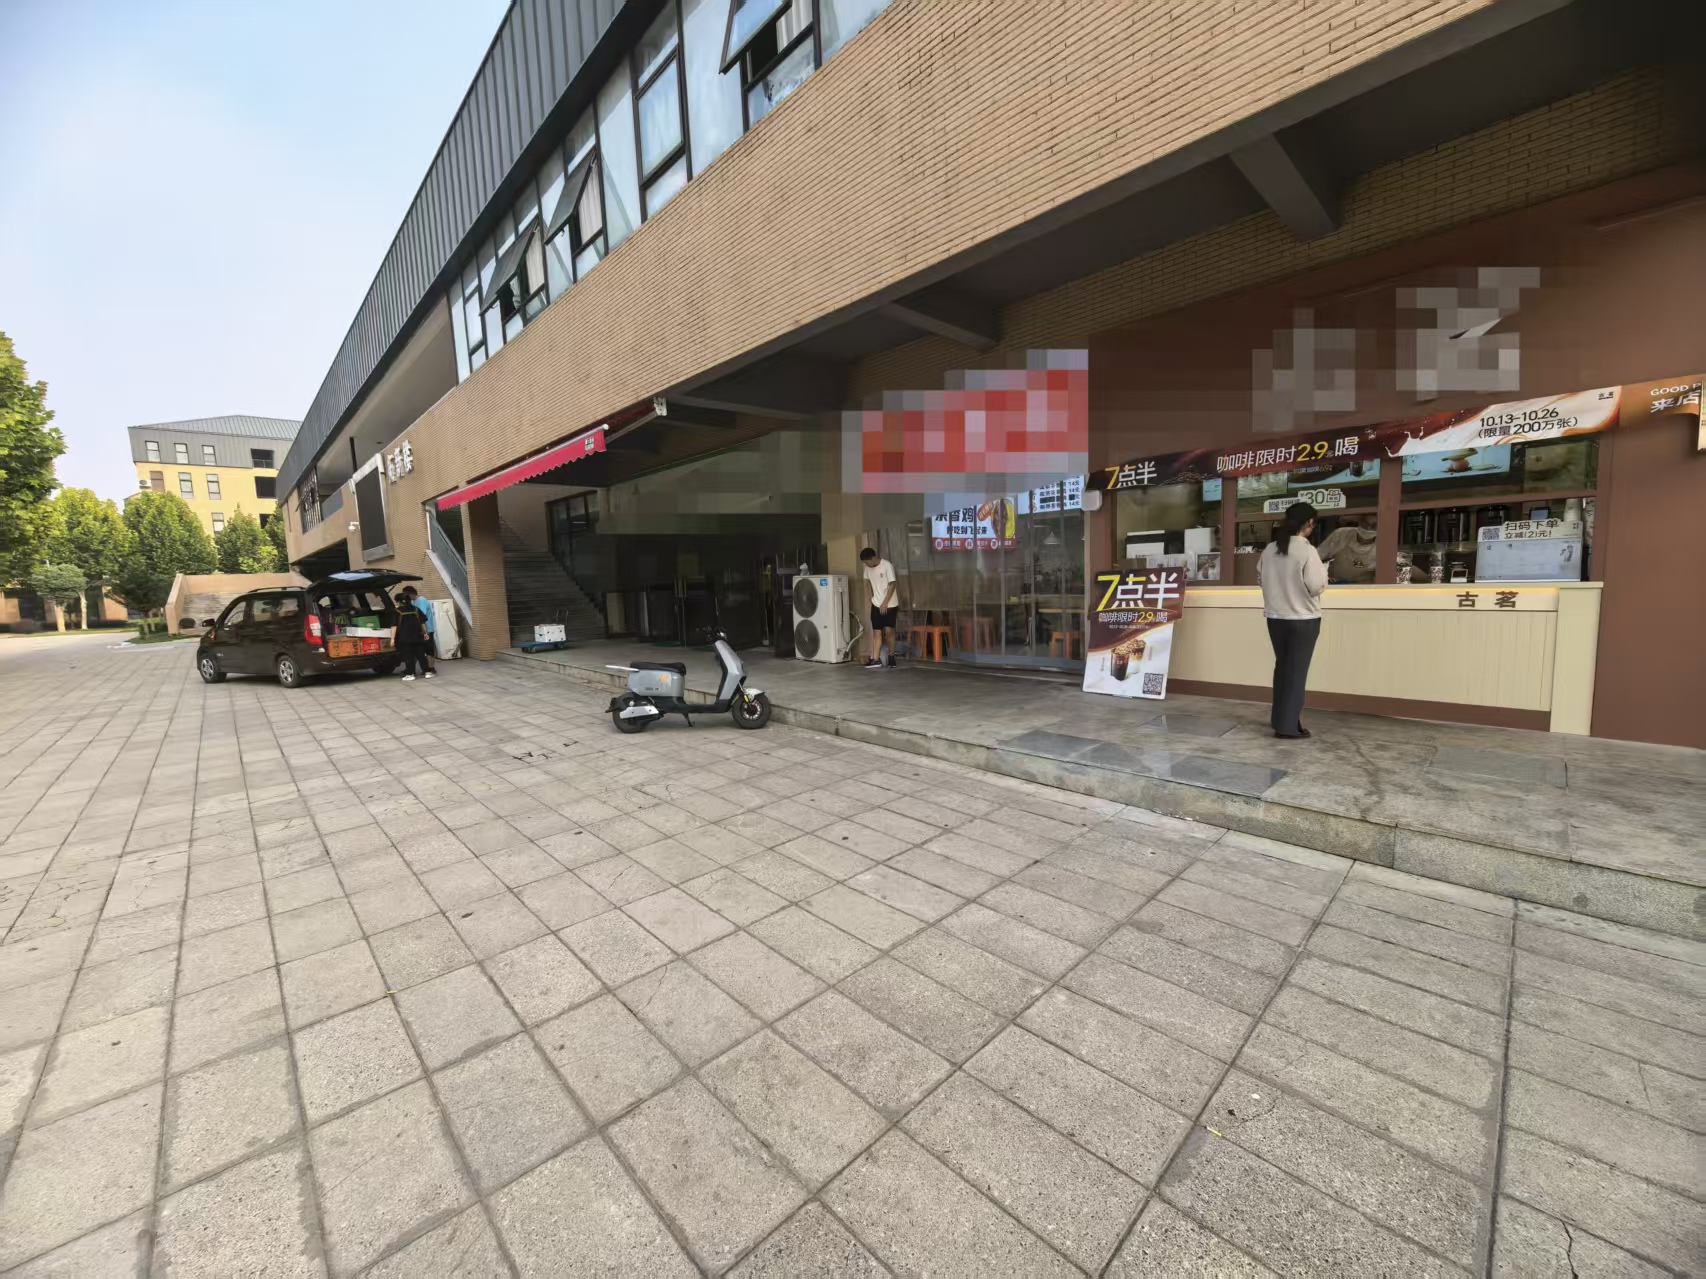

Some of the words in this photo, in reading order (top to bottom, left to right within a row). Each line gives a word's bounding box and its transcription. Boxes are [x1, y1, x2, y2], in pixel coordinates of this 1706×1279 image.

[1650, 384, 1689, 396] GOOD
[1217, 436, 1360, 473] 咖啡限时2.9元喝
[1105, 461, 1157, 489] 7点半
[1505, 519, 1560, 531] 扫码下单
[1097, 572, 1180, 611] 7点半
[1456, 591, 1519, 608] 古茗
